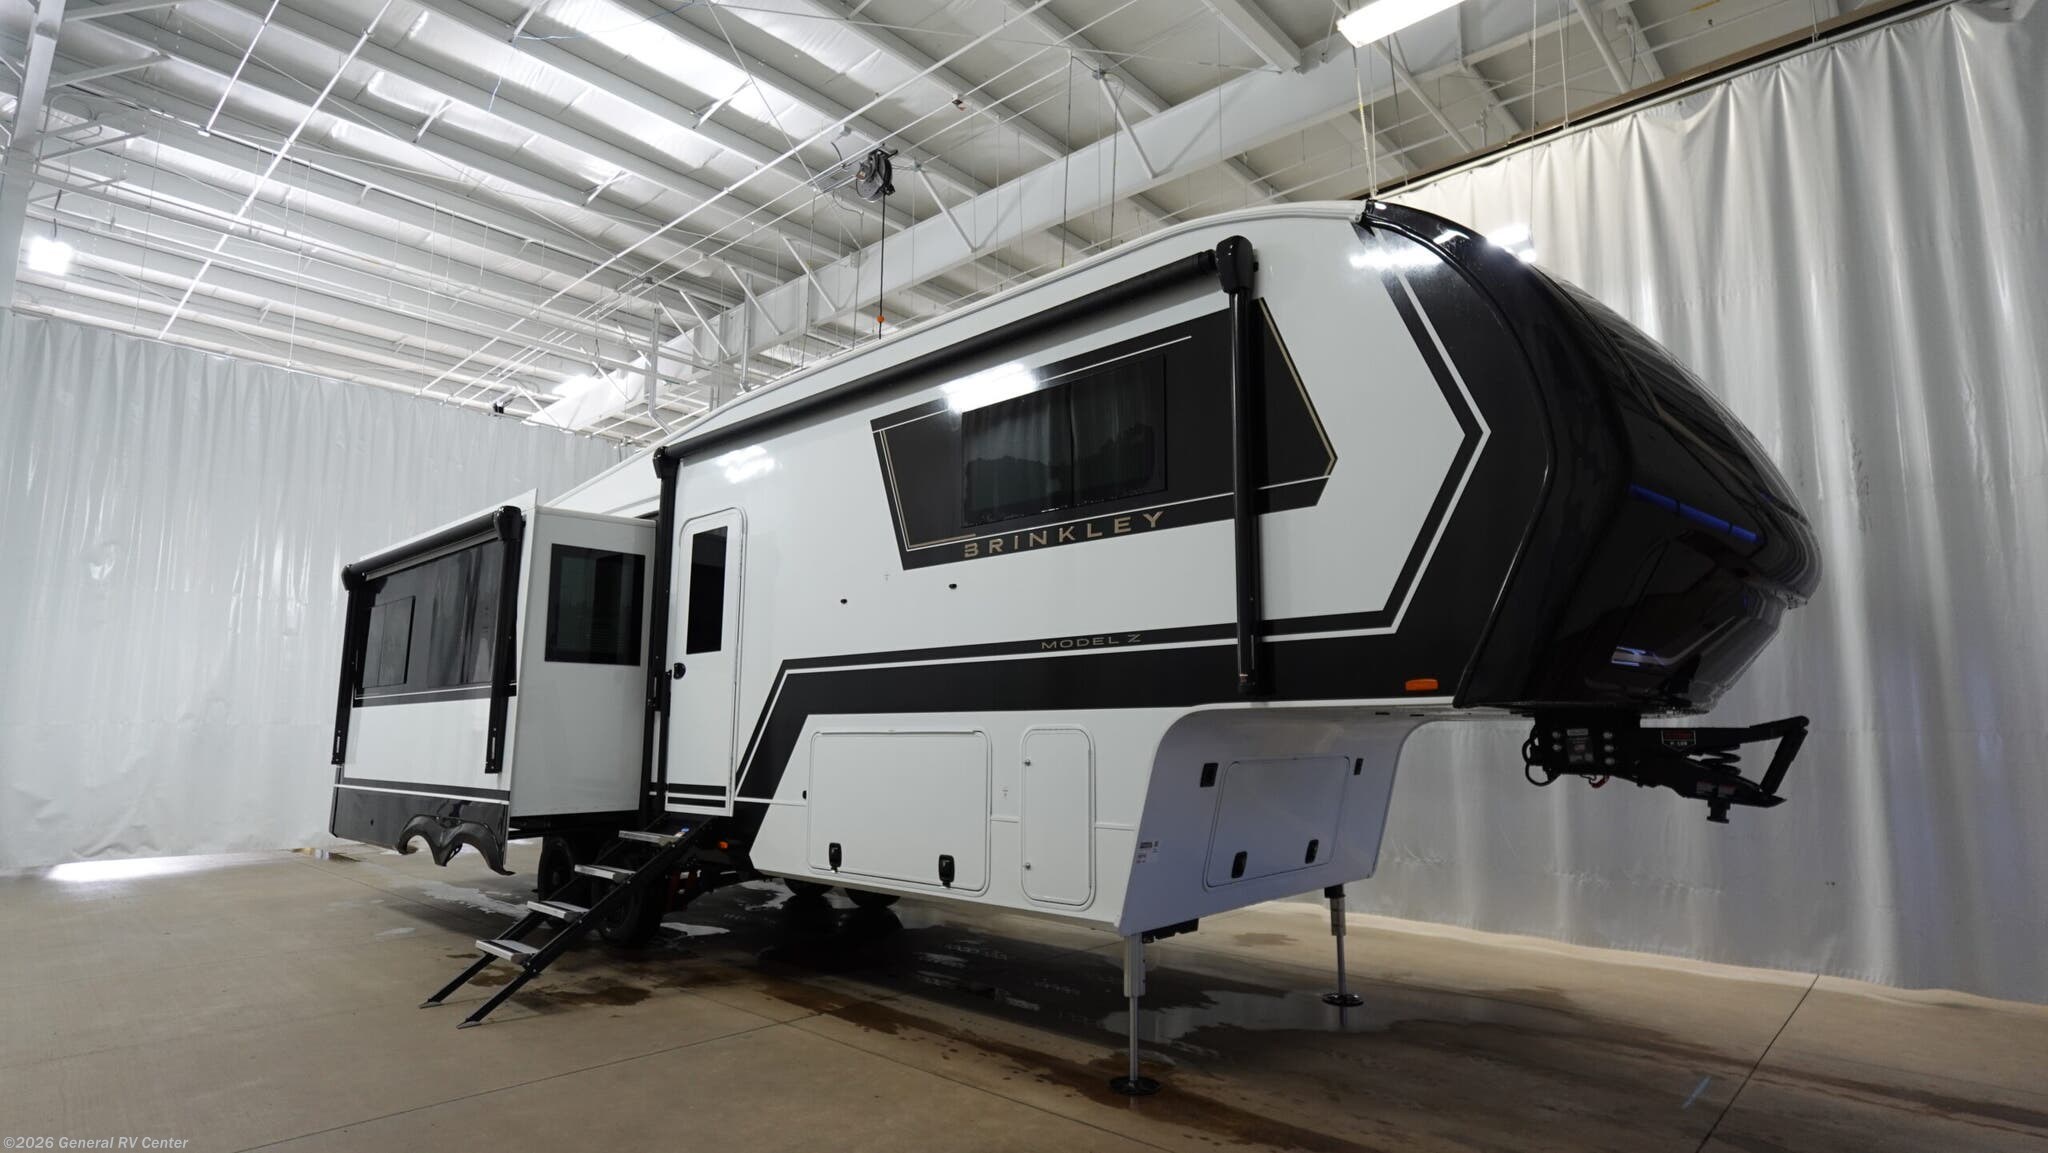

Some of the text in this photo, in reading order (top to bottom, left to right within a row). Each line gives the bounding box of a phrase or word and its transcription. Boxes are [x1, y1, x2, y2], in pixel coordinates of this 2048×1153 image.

[963, 511, 1164, 558] BRINKLEY
[1041, 633, 1141, 649] MODEL Z
